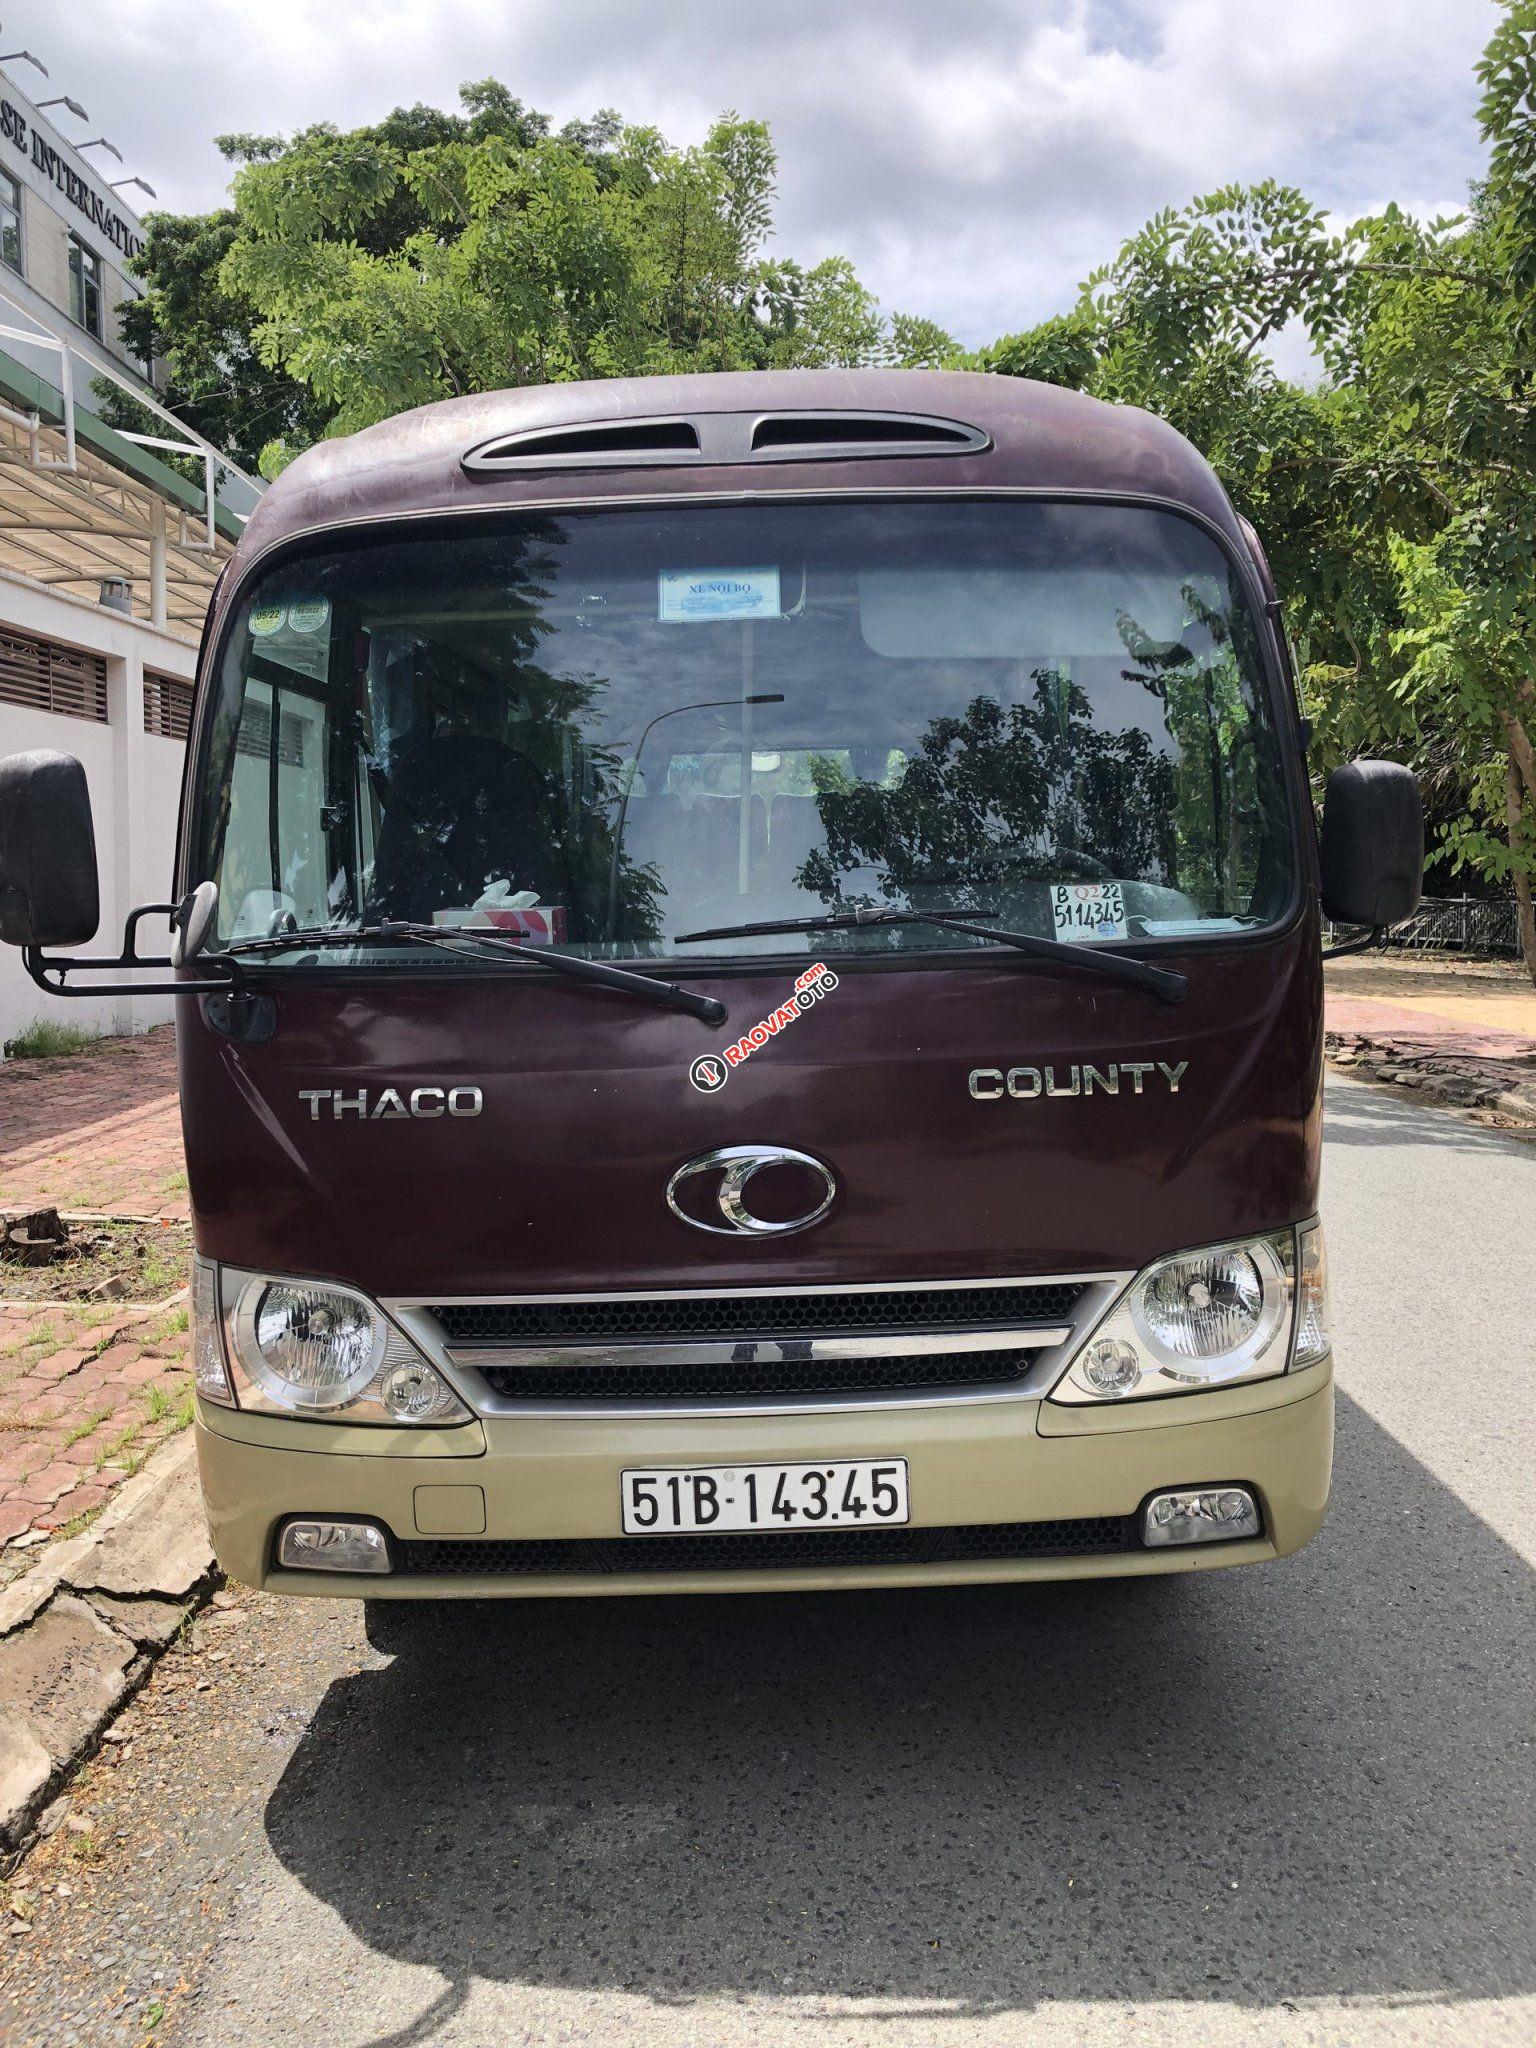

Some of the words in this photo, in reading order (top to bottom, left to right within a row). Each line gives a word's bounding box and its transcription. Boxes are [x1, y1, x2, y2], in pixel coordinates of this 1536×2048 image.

[689, 584, 705, 594] XE
[256, 609, 280, 620] 05/22
[1057, 886, 1069, 903] B
[1074, 887, 1099, 900] Q2
[1101, 884, 1120, 899] 22
[968, 1061, 1189, 1100] COUNTY
[298, 1086, 483, 1121] THACO
